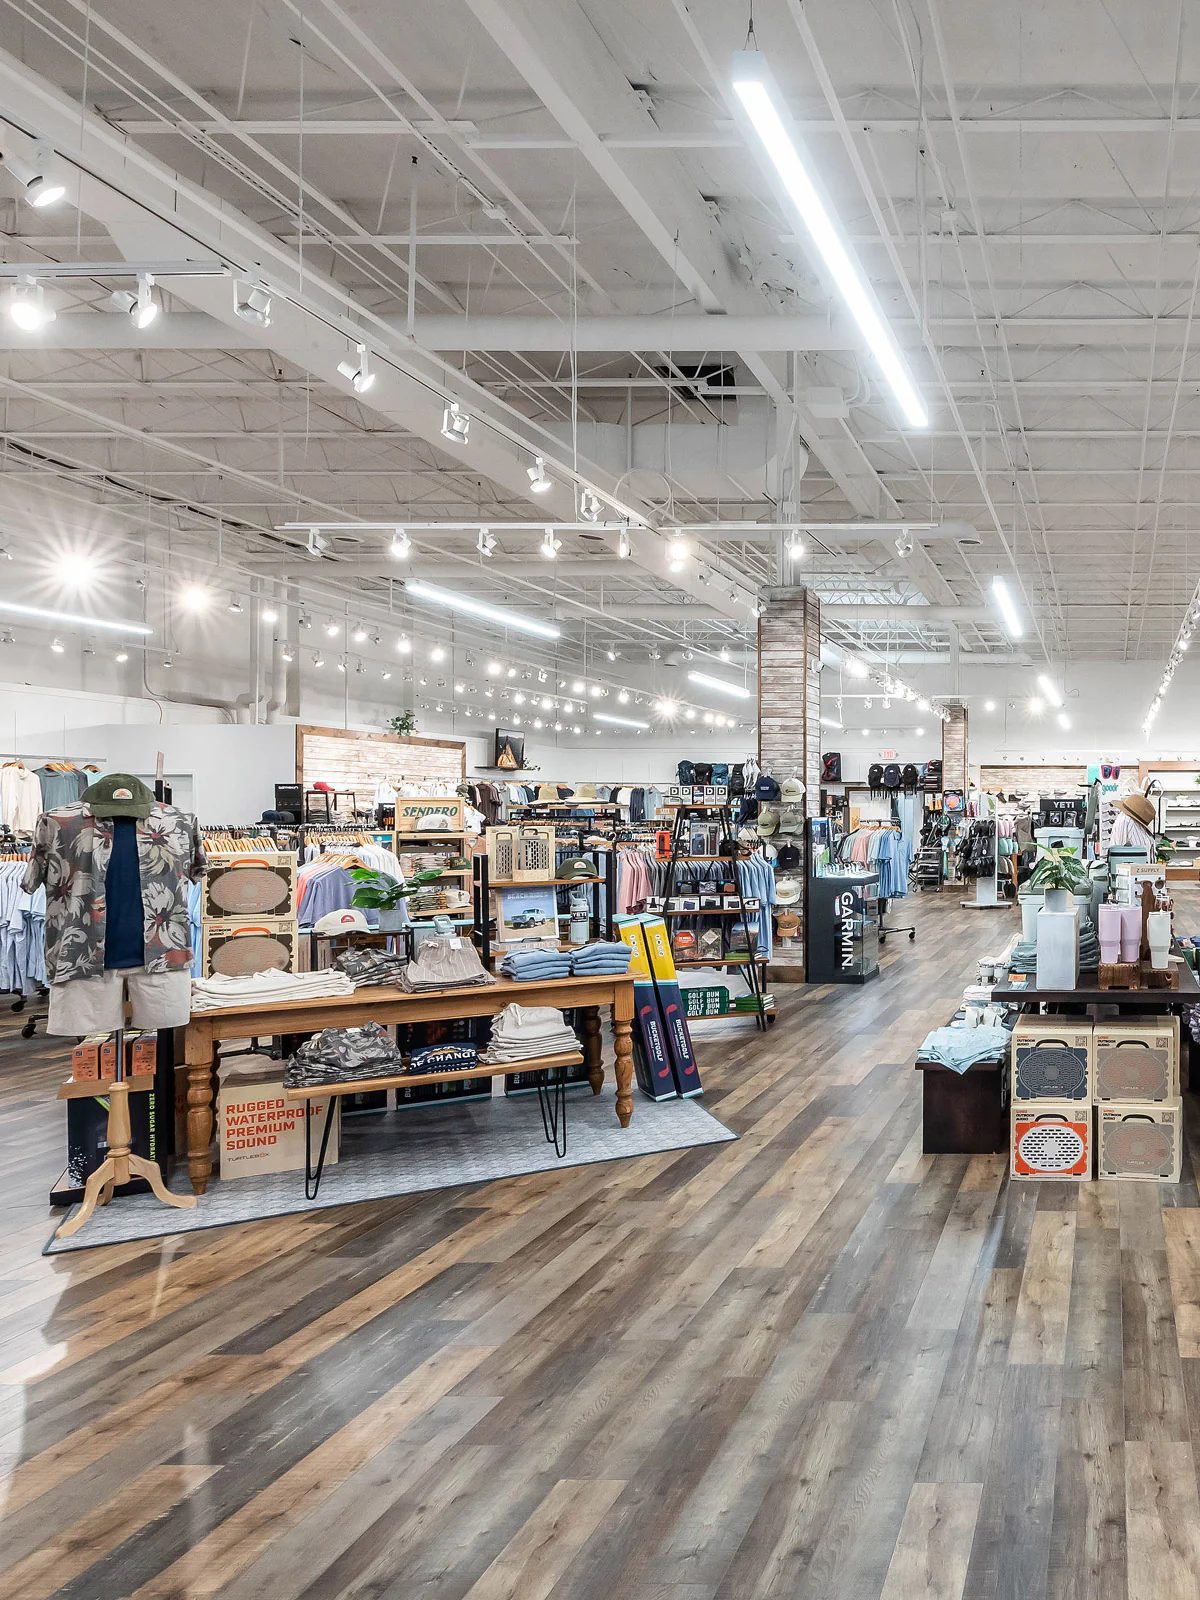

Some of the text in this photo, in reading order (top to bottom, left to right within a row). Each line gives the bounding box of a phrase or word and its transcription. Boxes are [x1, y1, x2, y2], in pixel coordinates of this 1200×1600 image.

[1102, 783, 1119, 795] goodr
[403, 806, 458, 818] SENDERO
[1053, 801, 1075, 809] YETI
[841, 892, 853, 967] GARMIN
[649, 1020, 664, 1062] BUCKETGOLF
[675, 1019, 690, 1059] BUCKETGOLF
[226, 1098, 285, 1114] RUGGED
[226, 1121, 295, 1138] PREMIUM
[226, 1135, 277, 1151] SOUND
